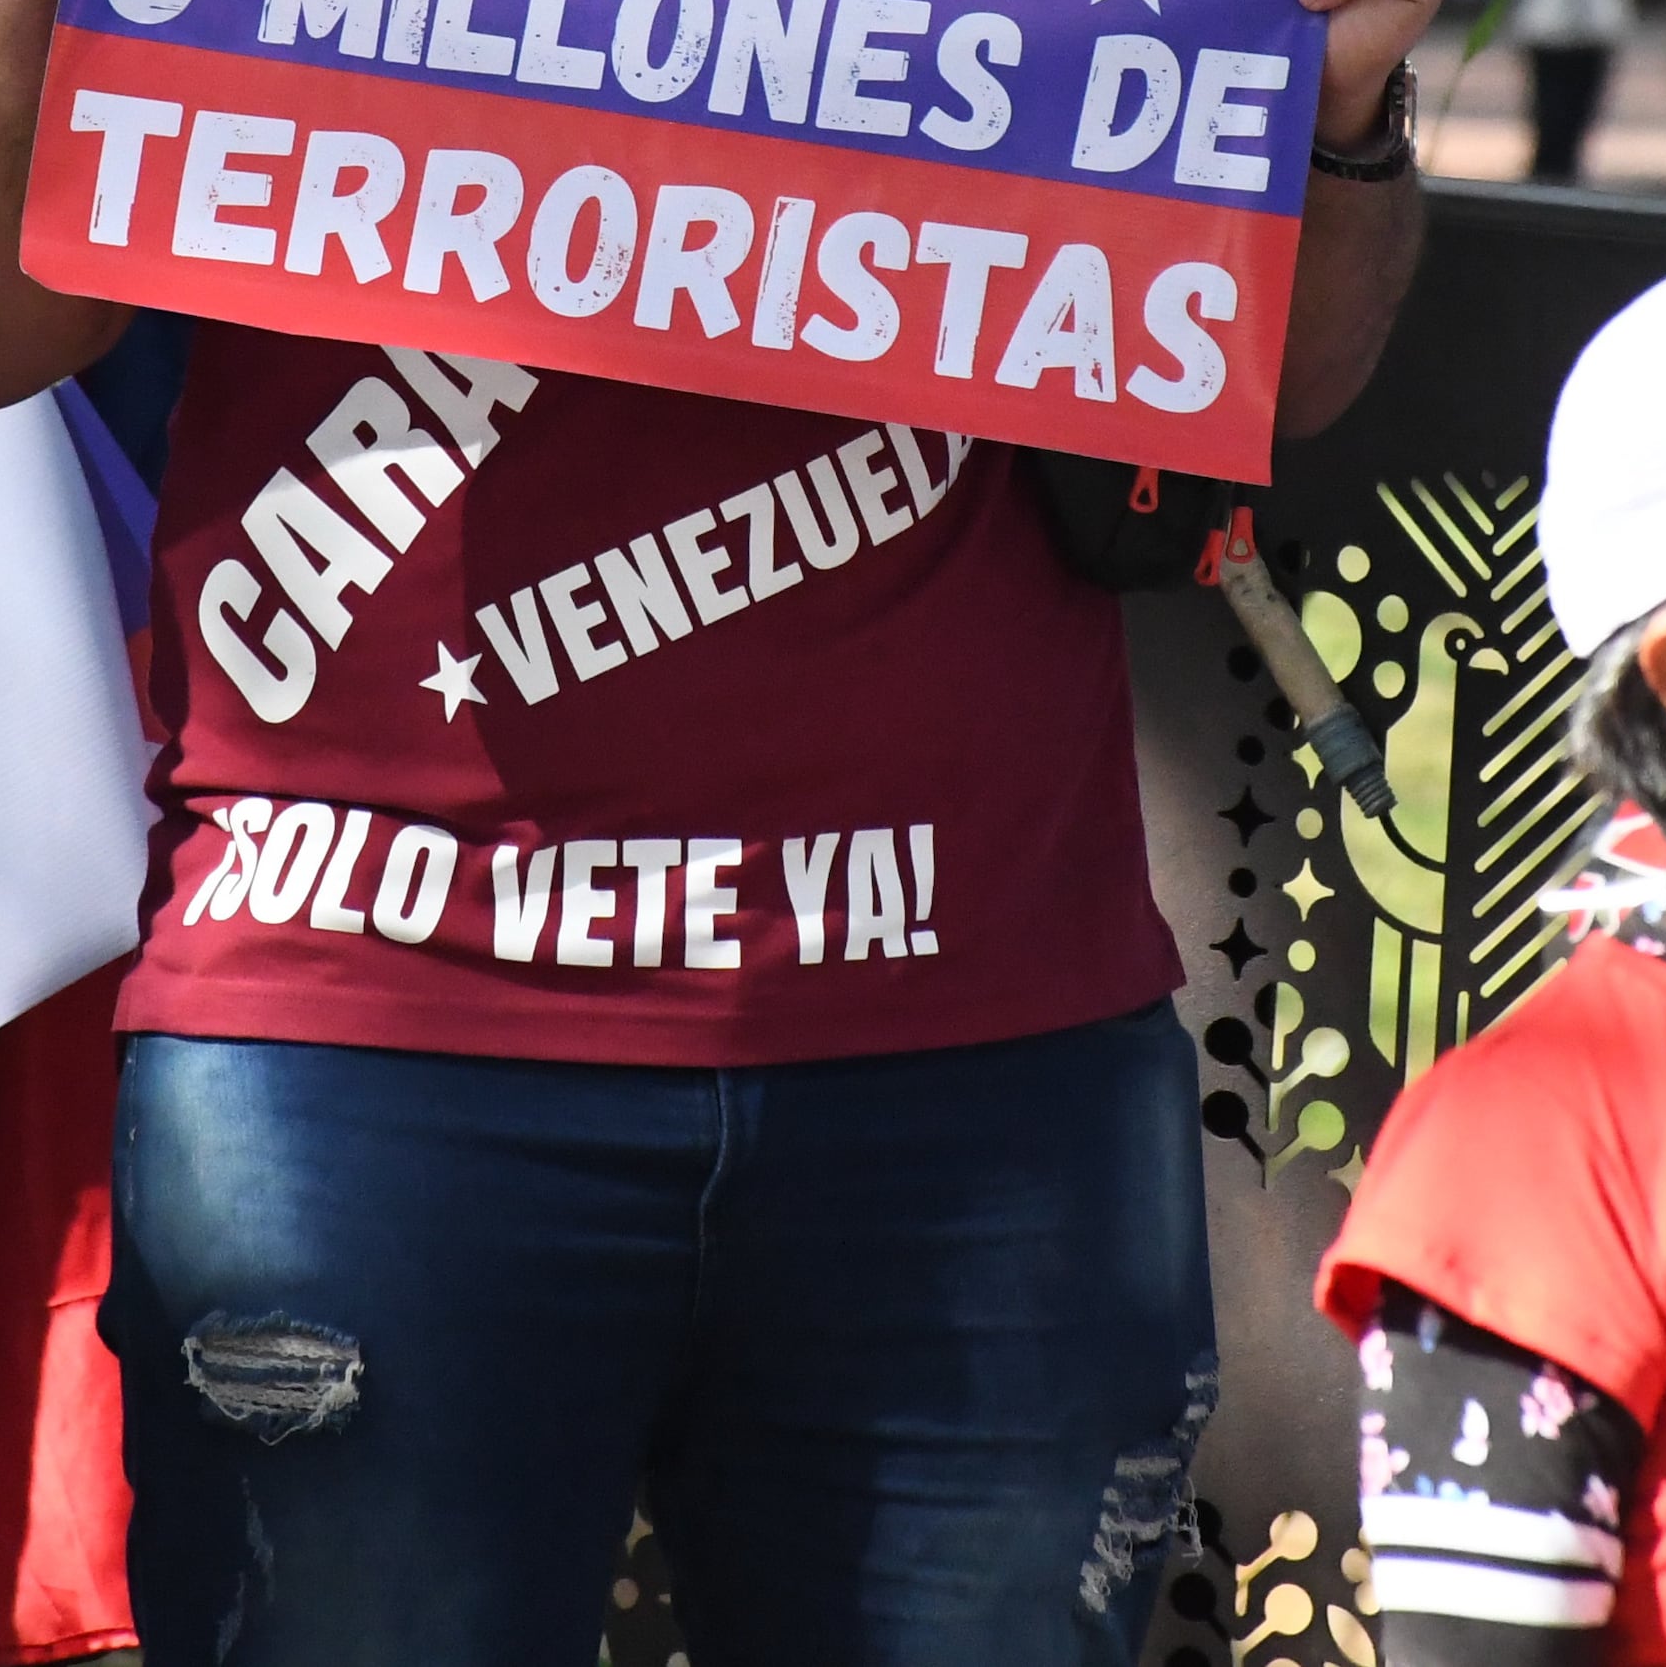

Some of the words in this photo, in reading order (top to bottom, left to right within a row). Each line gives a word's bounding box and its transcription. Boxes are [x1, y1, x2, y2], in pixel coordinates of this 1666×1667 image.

[1073, 34, 1290, 194] DE
[71, 89, 1238, 414] TERRORISTAS
[491, 837, 743, 969] VETE
[782, 823, 939, 965] YA!
